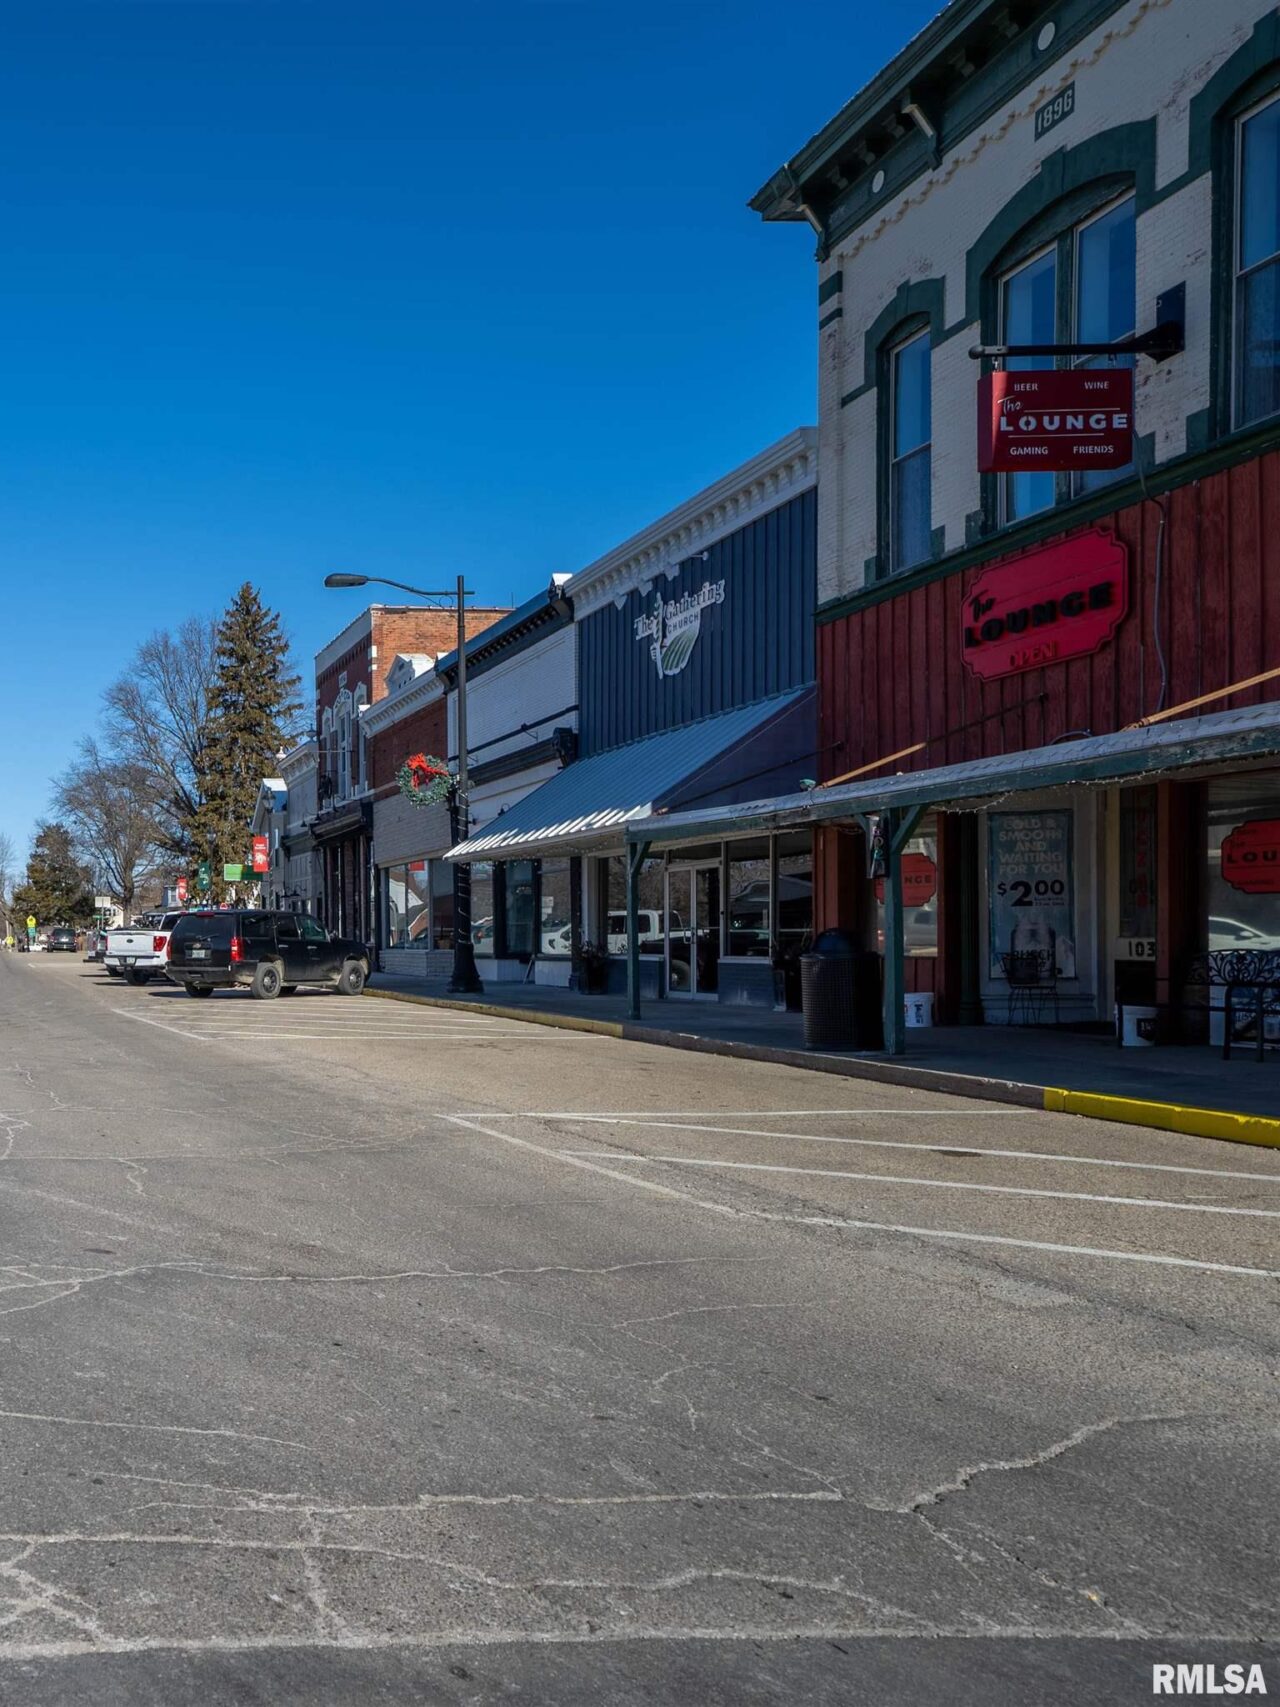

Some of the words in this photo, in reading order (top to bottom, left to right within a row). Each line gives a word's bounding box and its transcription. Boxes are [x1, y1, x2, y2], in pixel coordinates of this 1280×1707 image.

[1038, 89, 1072, 133] 1896
[1014, 383, 1039, 391] BEER
[1084, 381, 1109, 390] WINE
[997, 395, 1022, 414] The
[1000, 413, 1128, 432] LOUNGE
[1010, 446, 1049, 456] GAMING
[1073, 445, 1114, 454] FRIENDS
[634, 614, 654, 640] The
[664, 579, 725, 622] Gathering
[965, 581, 1114, 648] LOUNGE
[668, 613, 699, 634] CHURCH
[1003, 818, 1041, 829] COLD
[999, 829, 1063, 841] SMOOTH
[1015, 841, 1046, 851] AND
[999, 852, 1063, 863] WAITING
[999, 864, 1026, 875] FOR
[1033, 863, 1063, 874] YOU
[1129, 941, 1155, 957] 103
